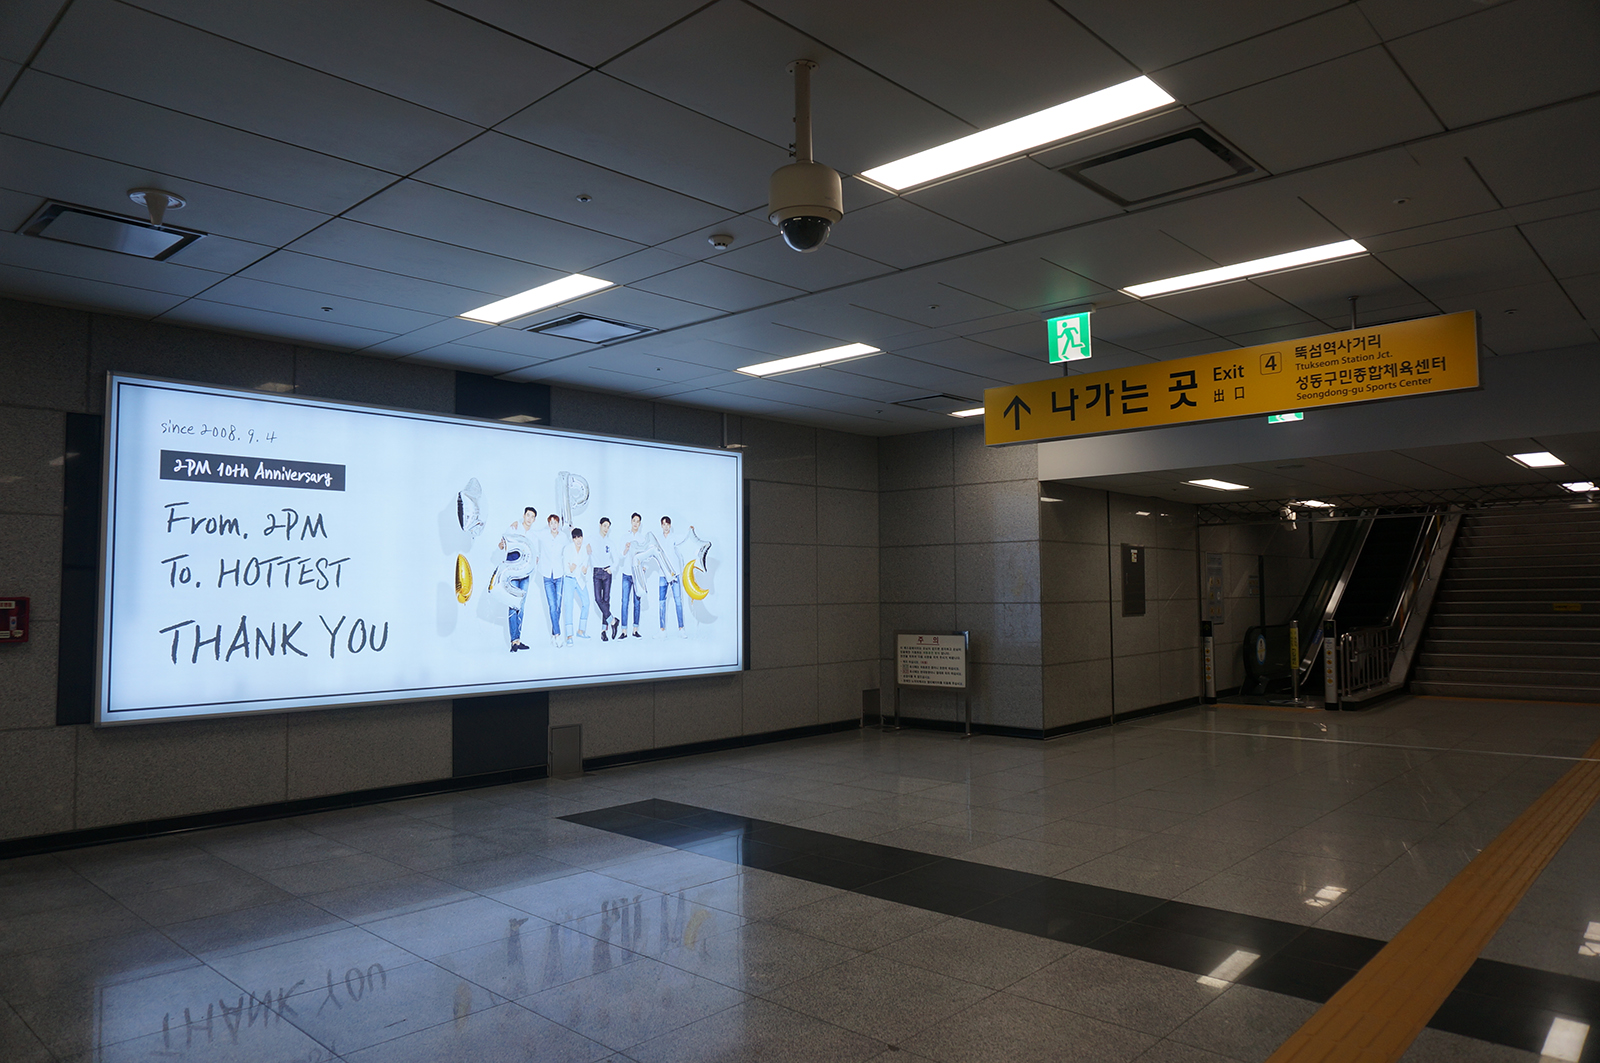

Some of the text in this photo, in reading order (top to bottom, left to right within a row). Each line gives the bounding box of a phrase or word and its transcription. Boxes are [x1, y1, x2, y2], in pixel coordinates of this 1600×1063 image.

[1295, 334, 1382, 360] 뚝섬역사거리
[1213, 364, 1245, 382] Exit
[1264, 355, 1278, 371] 4
[1295, 351, 1394, 371] Ttukseom Station Jct.
[1296, 356, 1447, 391] 성동구민종합체육센터
[1051, 370, 1198, 421] 나가는 곳
[1296, 377, 1433, 401] Seongdong-gu Sports Center
[161, 420, 195, 435] since
[200, 424, 241, 442] 2008.
[266, 431, 278, 443] 4
[173, 458, 334, 487] 2PM 10th Anniversary
[164, 501, 328, 541] From. 2PM
[161, 554, 351, 591] To. HOTTEST
[159, 614, 389, 665] THANK YOU
